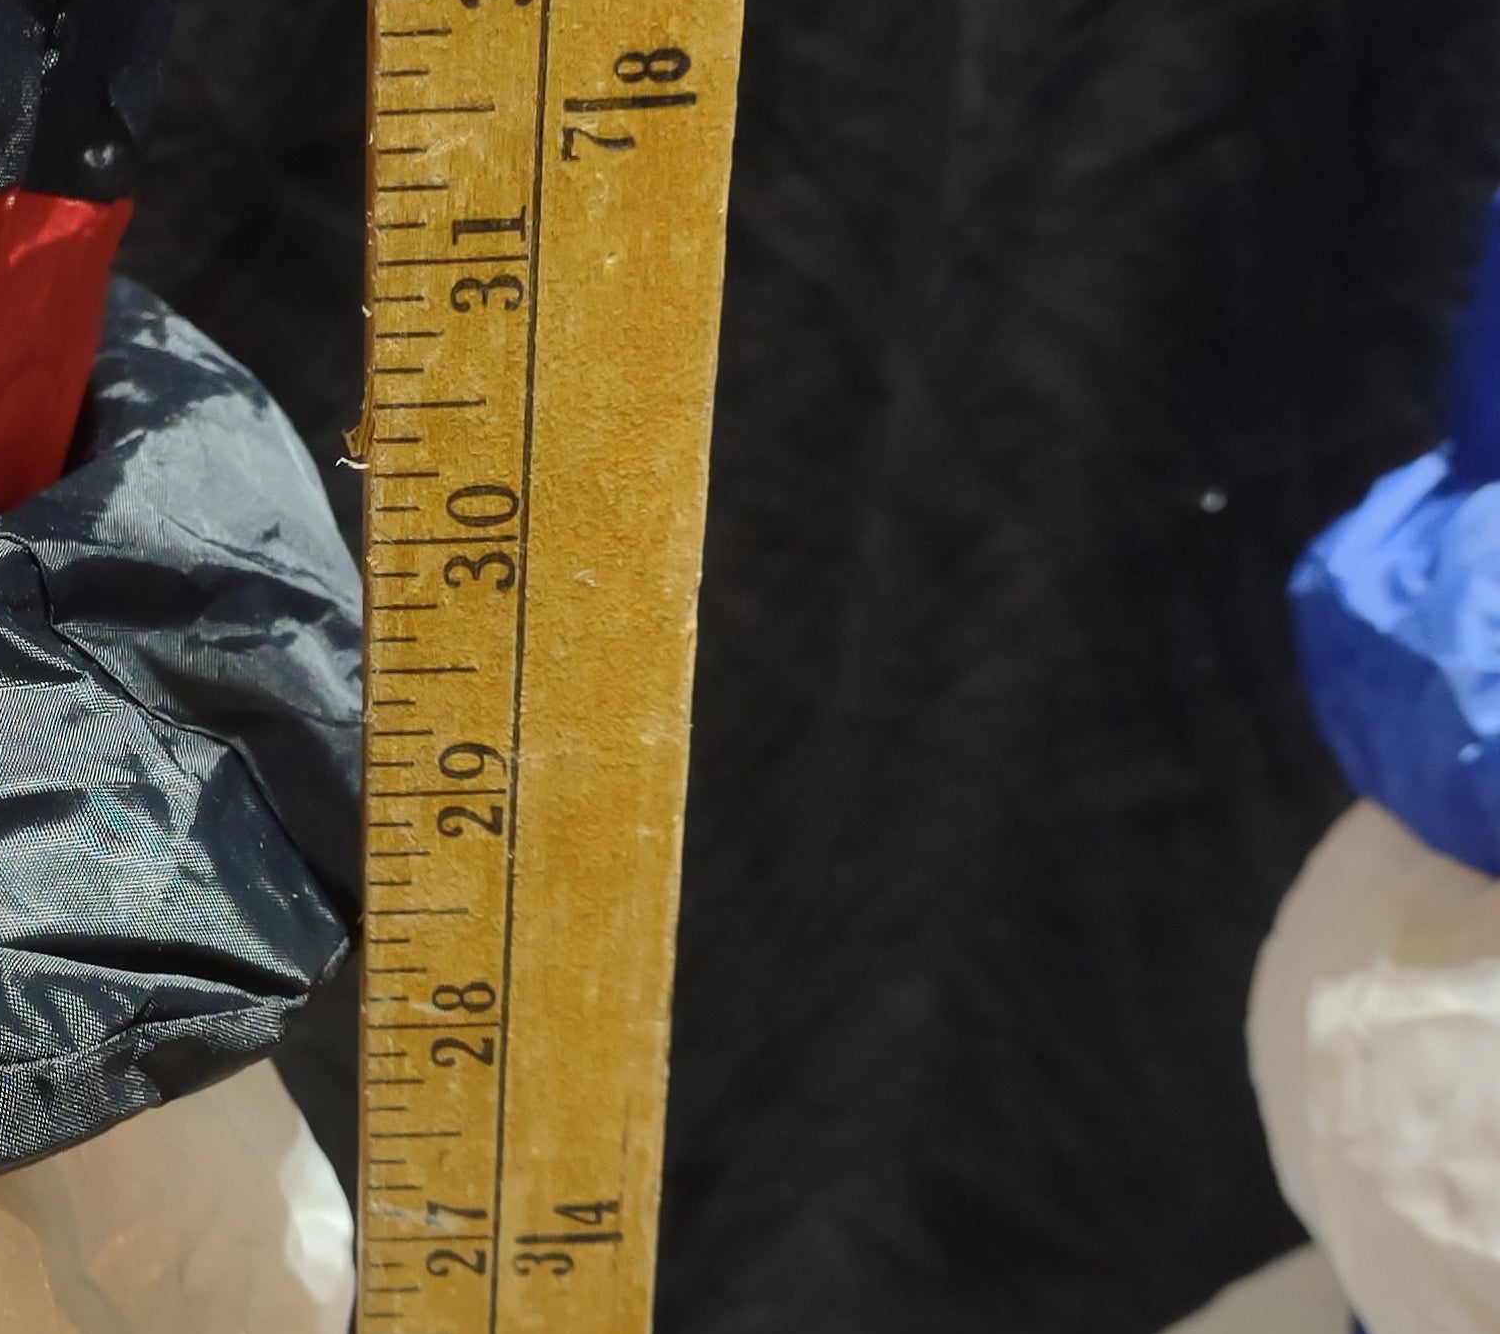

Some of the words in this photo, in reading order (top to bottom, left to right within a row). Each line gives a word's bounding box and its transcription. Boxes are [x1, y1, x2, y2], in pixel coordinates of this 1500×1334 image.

[450, 205, 528, 312] 31
[444, 483, 520, 594] 30
[437, 742, 507, 837] 29
[431, 981, 495, 1067] 28
[426, 1200, 488, 1276] 27
